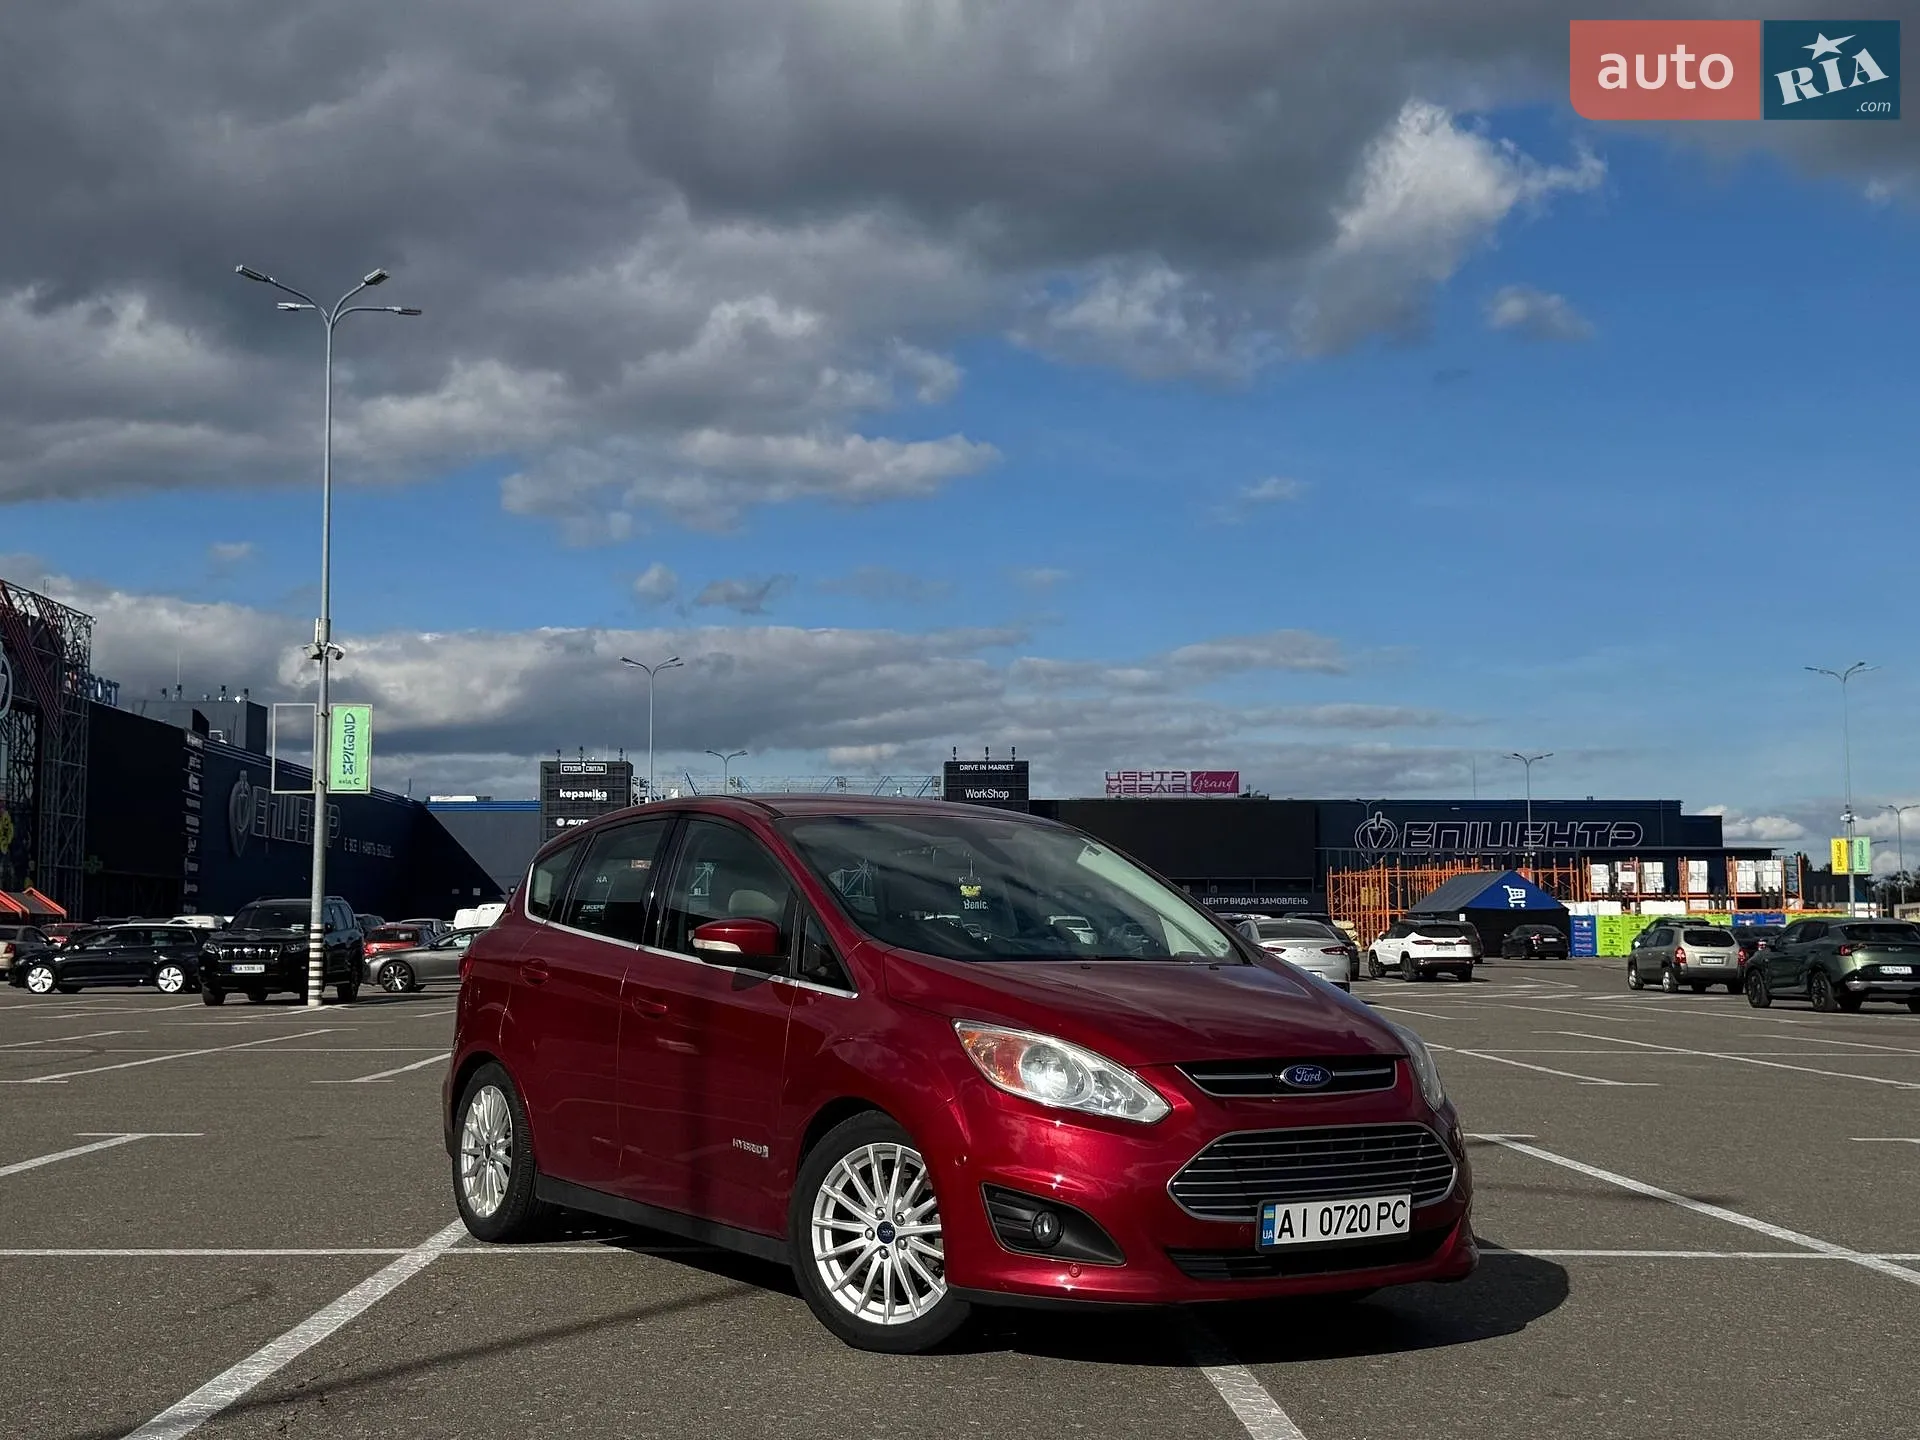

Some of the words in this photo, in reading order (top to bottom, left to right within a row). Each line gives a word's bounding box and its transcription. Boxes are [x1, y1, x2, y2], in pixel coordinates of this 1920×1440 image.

[1192, 771, 1237, 792] Grand
[965, 788, 1010, 800] WorkShop
[1202, 897, 1229, 906] ЦЕНТР
[1229, 897, 1259, 906] ВИДАЧІ
[1260, 897, 1309, 905] ЗАМОВЛЕНЬ
[1294, 1067, 1322, 1082] Ford
[1277, 1208, 1307, 1239] AI
[1319, 1203, 1371, 1237] 0720
[1376, 1199, 1406, 1232] PC
[1262, 1229, 1274, 1239] UA
